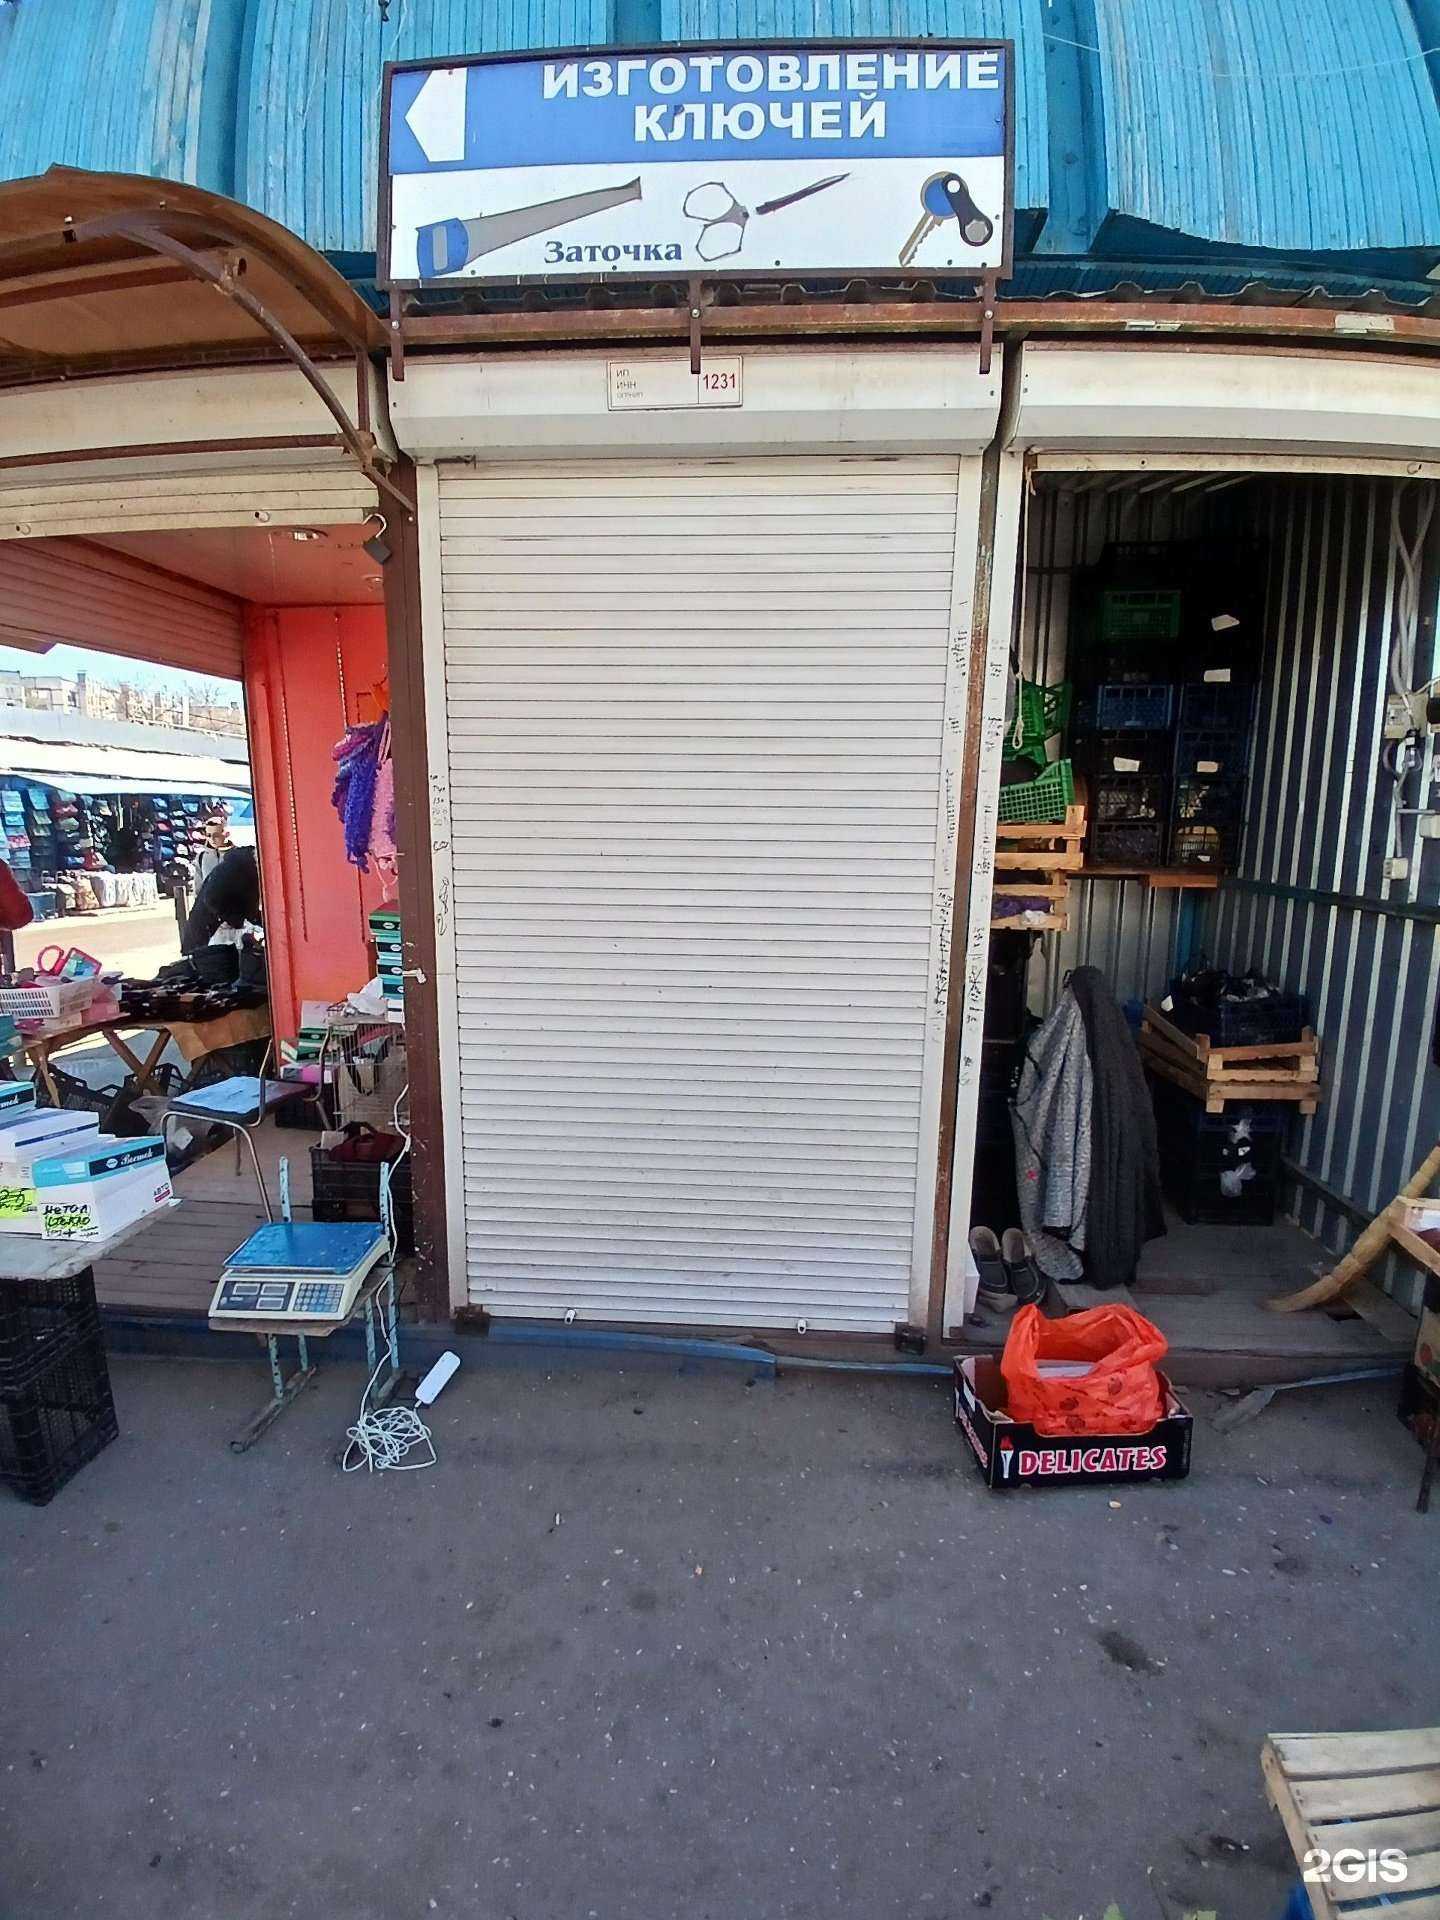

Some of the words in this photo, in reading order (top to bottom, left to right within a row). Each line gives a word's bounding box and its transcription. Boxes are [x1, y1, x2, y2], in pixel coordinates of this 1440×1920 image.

[543, 53, 999, 99] ИЗГОТОВЛЕНИЕ
[634, 91, 886, 142] КЛЮЧЕЙ
[544, 241, 682, 264] Заточка
[616, 368, 630, 378] ИП
[702, 373, 736, 390] 1231
[616, 381, 637, 389] ИНН
[1018, 1446, 1168, 1476] DELICATES
